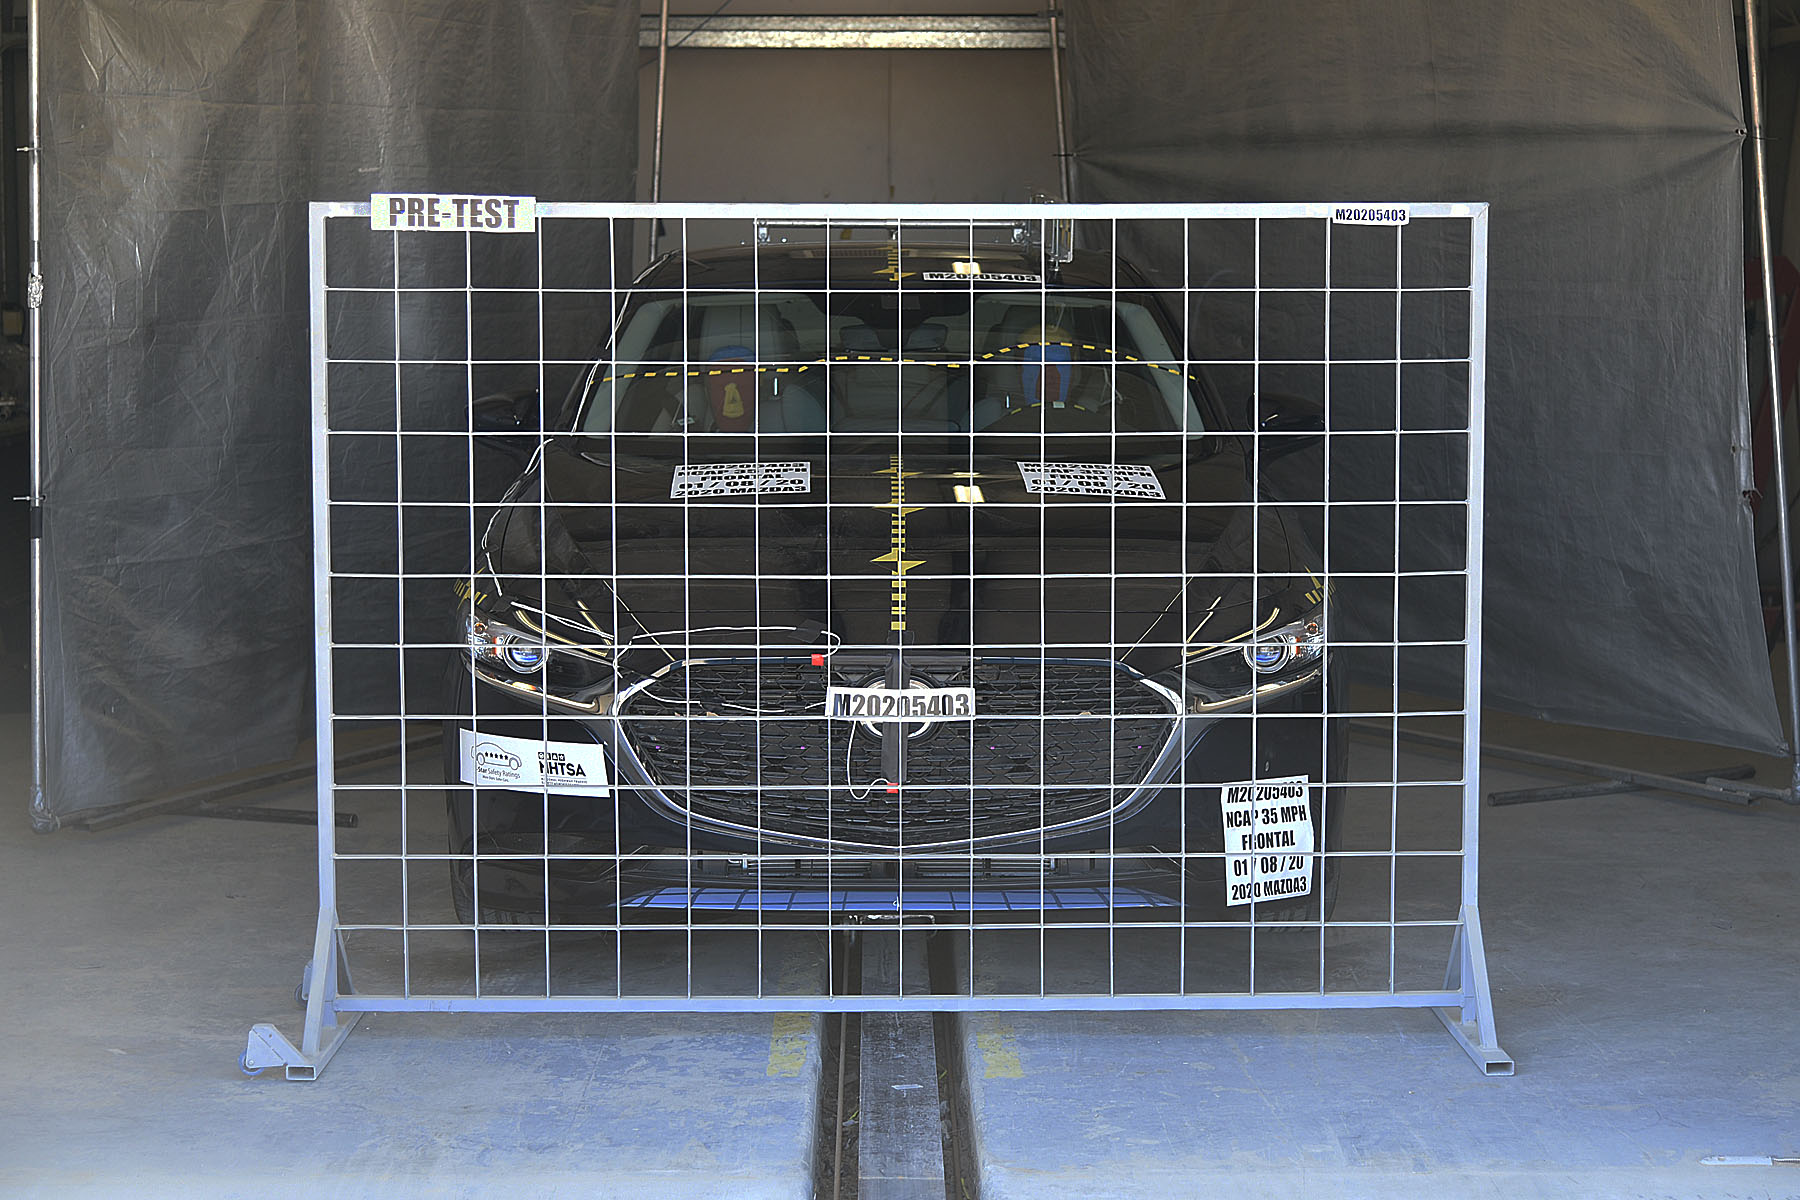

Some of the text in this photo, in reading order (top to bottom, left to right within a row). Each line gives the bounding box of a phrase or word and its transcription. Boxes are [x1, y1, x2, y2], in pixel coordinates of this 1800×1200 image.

[389, 197, 520, 229] PRE-TEST
[1335, 208, 1406, 221] M20205403
[928, 273, 1038, 282] M20205403
[681, 463, 805, 471] M20205403
[1023, 463, 1147, 471] M20205403
[677, 469, 729, 477] NCAP
[700, 474, 785, 482] FRONTAL
[1049, 474, 1134, 482] FRONTAL
[674, 485, 807, 496] 2020 MAZDA3
[1084, 488, 1162, 497] MAZDA3
[832, 693, 970, 717] M20205403
[538, 760, 587, 777] NHTSA
[1261, 807, 1278, 825] 35
[1281, 804, 1307, 823] MPH
[1241, 830, 1296, 851] FRONTAL
[1231, 876, 1307, 900] 2020 MAZDA3
